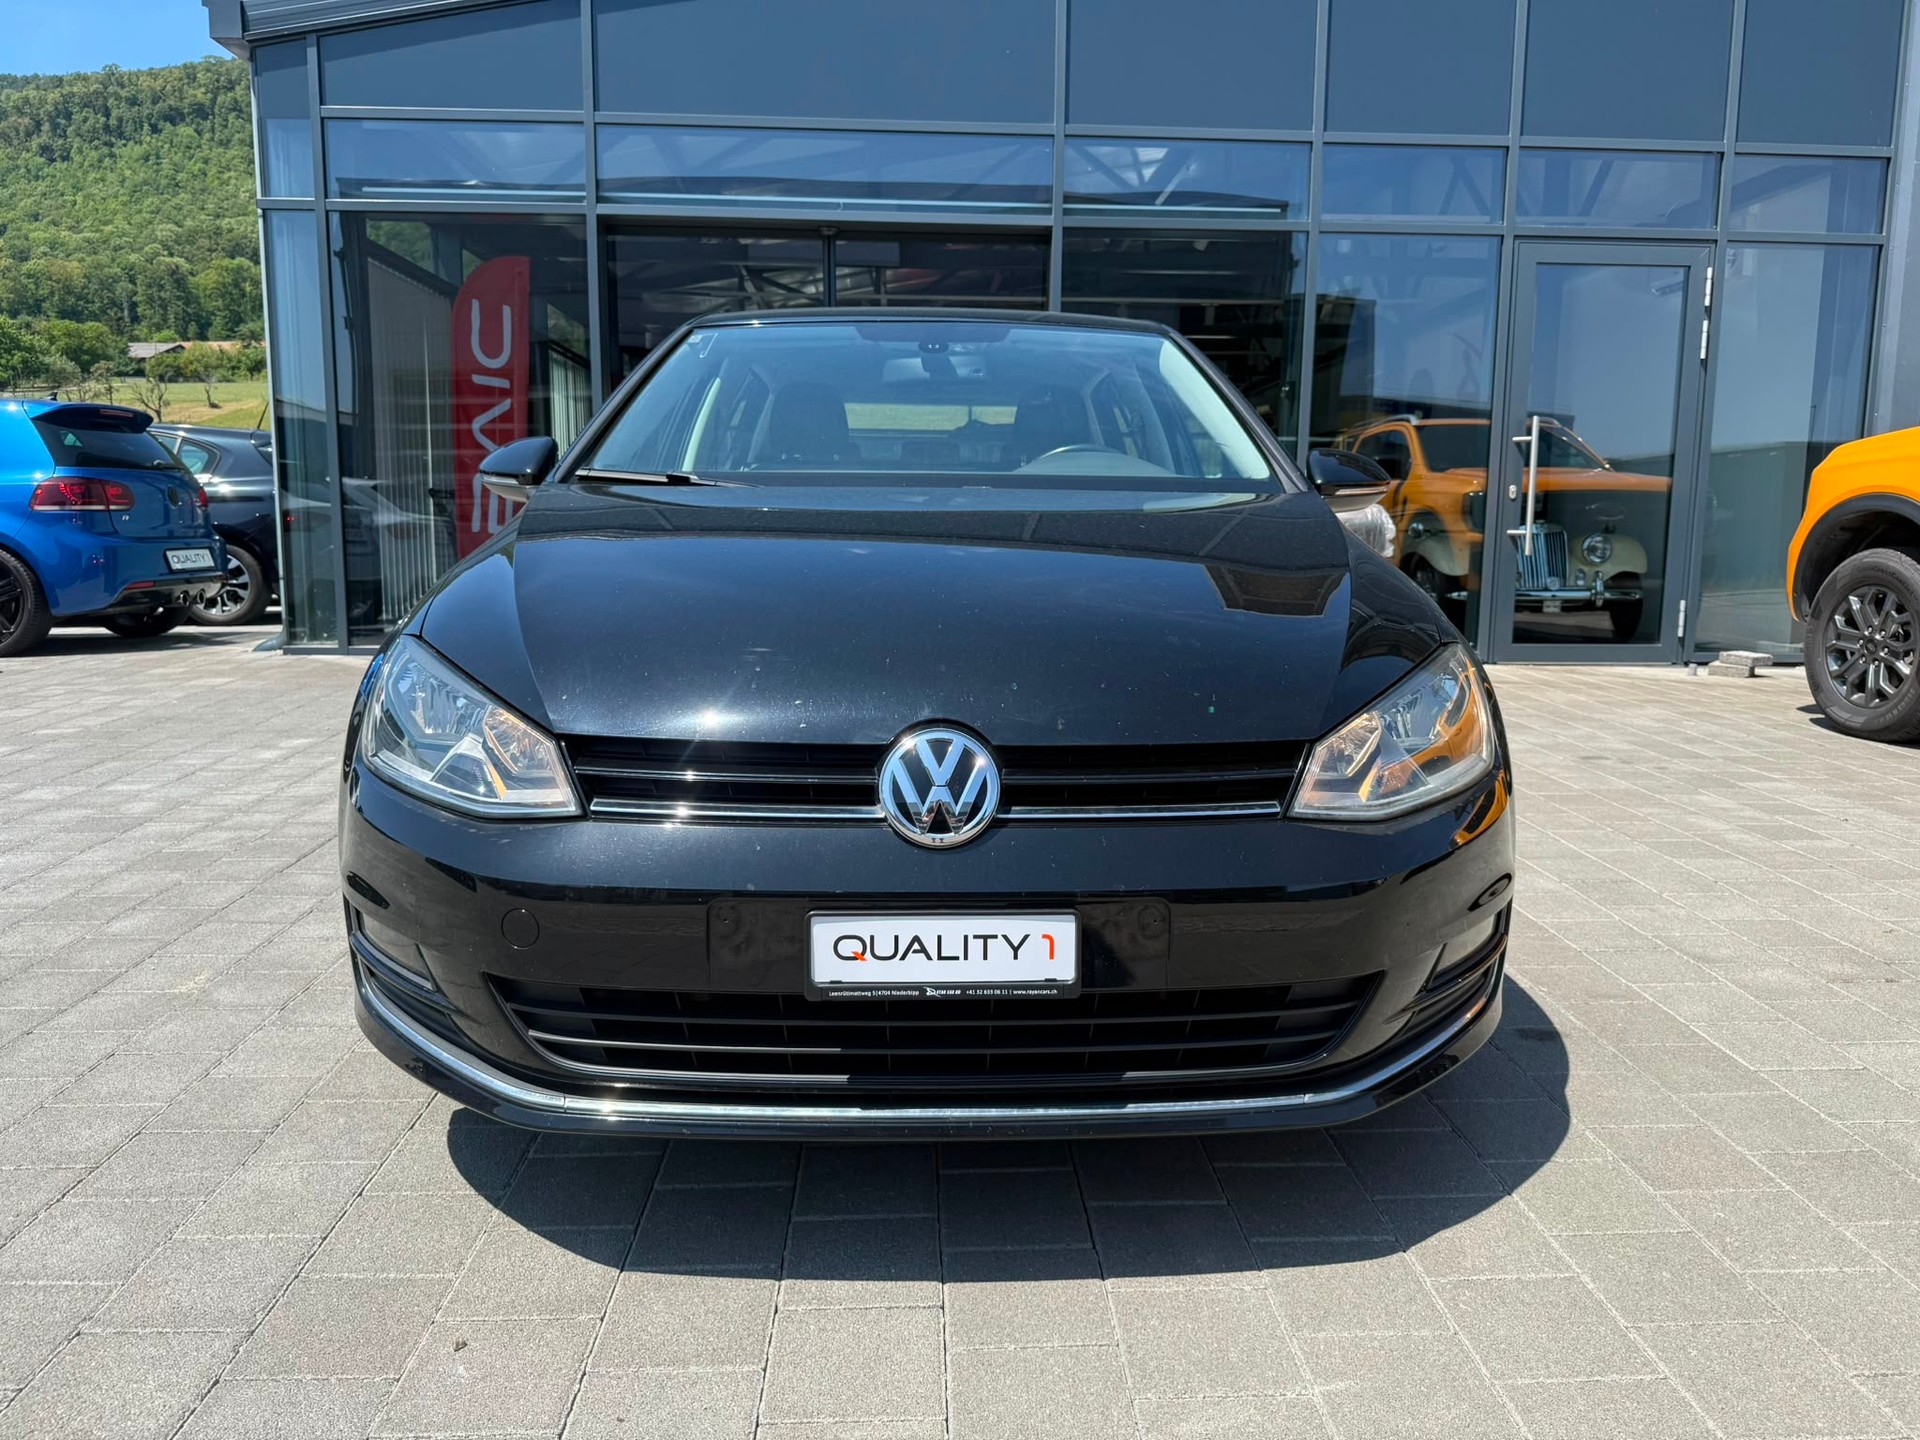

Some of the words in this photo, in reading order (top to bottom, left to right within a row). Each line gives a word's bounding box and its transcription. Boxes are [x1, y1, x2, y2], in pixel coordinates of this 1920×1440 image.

[171, 553, 206, 564] QUALITY
[832, 934, 1031, 962] QUALITY
[1041, 933, 1055, 961] 1
